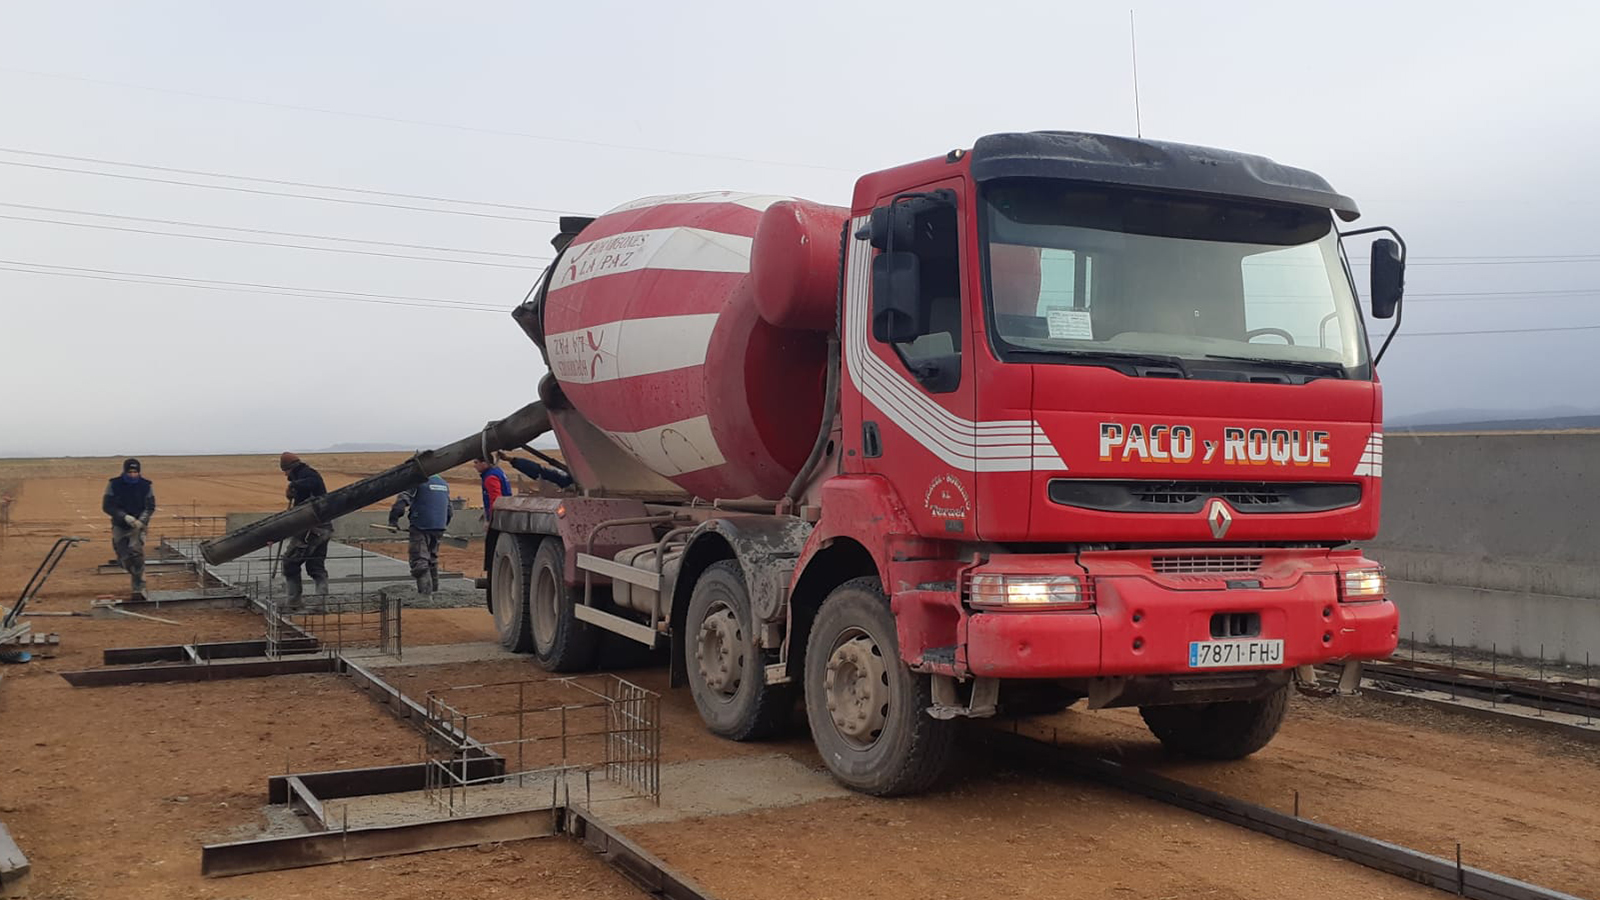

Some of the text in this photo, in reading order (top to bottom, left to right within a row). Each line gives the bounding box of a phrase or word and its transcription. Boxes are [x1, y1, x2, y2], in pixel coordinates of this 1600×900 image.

[580, 251, 634, 275] LA PAZ
[1099, 422, 1196, 463] PACO
[1224, 427, 1331, 467] ROQUE
[1201, 644, 1241, 664] 7871
[1249, 642, 1280, 662] FHJ
